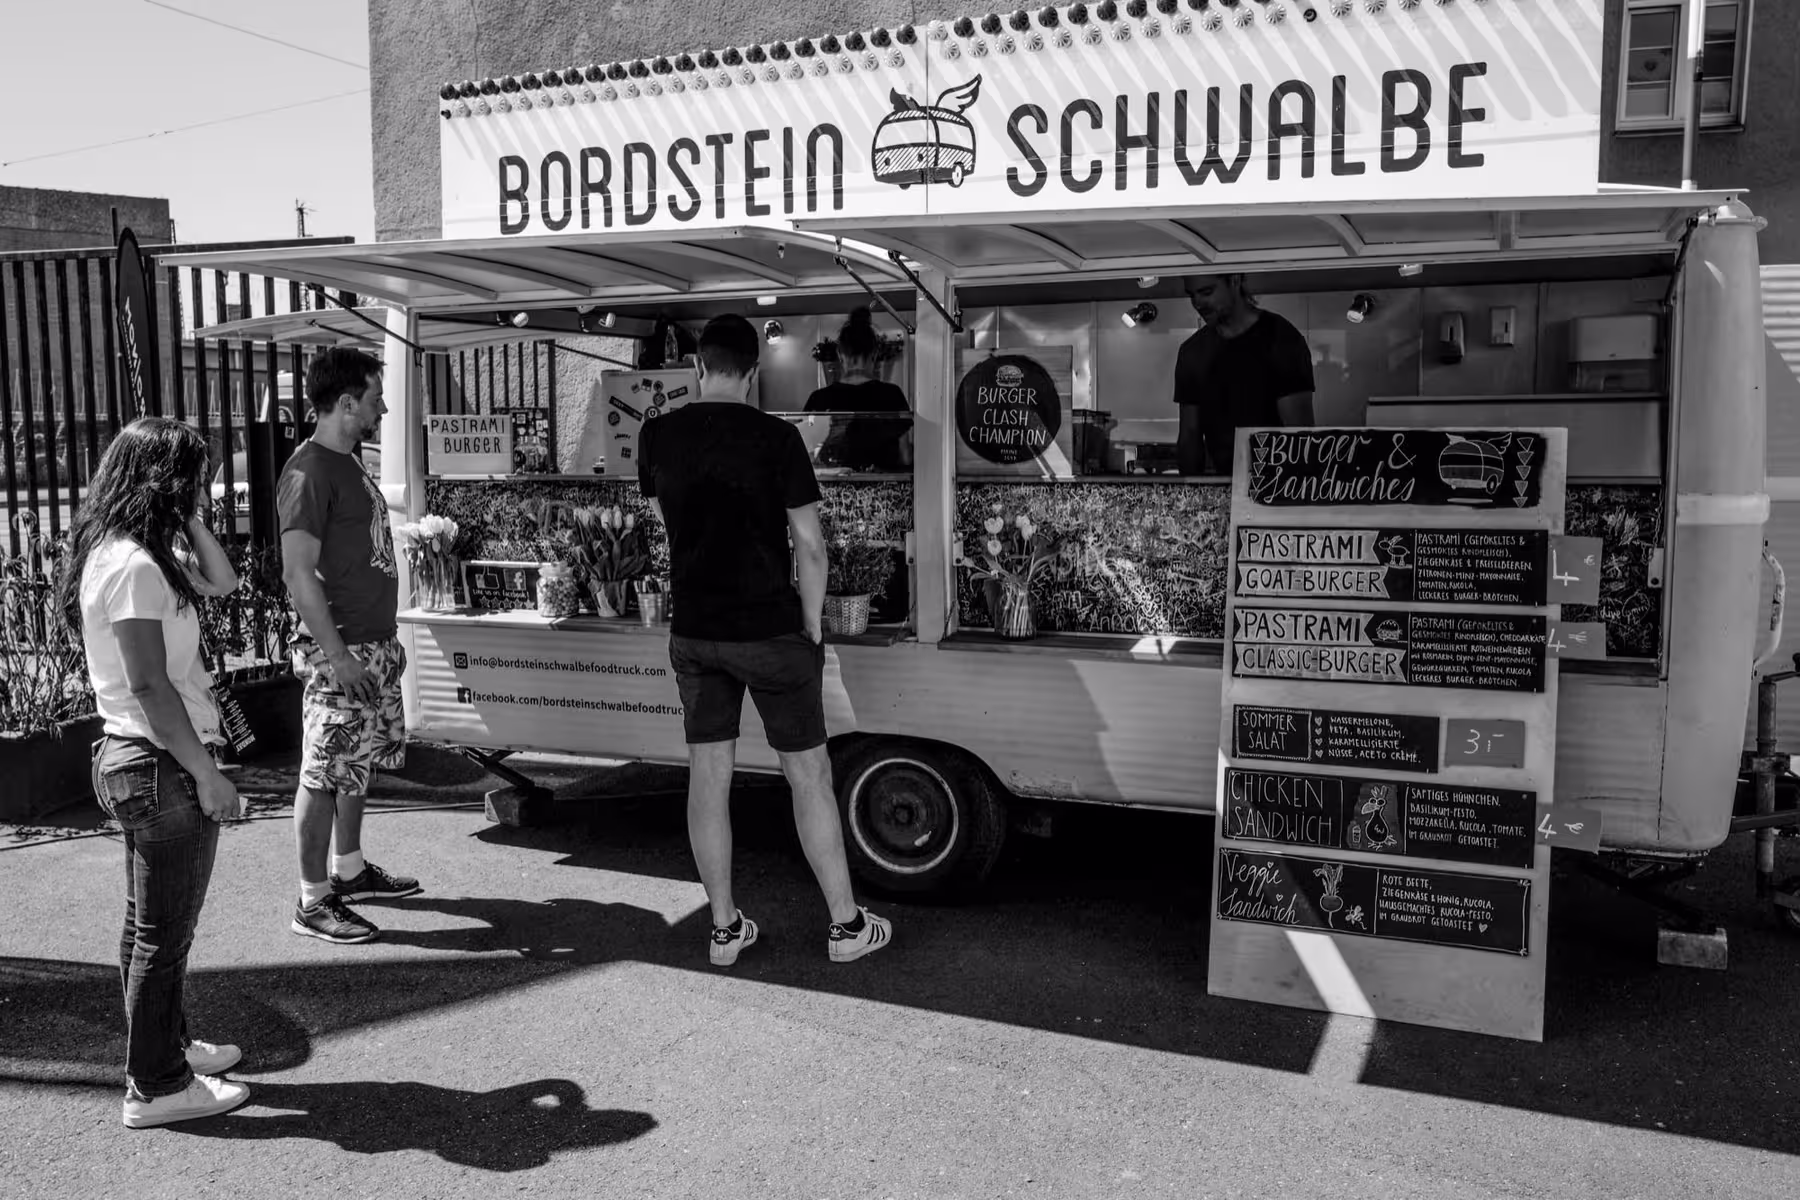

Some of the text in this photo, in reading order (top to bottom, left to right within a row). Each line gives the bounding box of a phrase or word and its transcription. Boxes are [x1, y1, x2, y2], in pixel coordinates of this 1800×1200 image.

[1006, 62, 1487, 197] SCHWALBE
[499, 123, 843, 235] BORDSTEIN
[978, 386, 1038, 405] BURGER
[431, 418, 504, 434] PASTRAMI
[983, 408, 1028, 426] CLASH
[969, 426, 1046, 446] CHAMPION
[1388, 433, 1417, 469] &
[1247, 533, 1363, 560] PASTRAMI
[1418, 532, 1460, 545] PASTRAMI
[1552, 548, 1580, 587] 4
[1245, 569, 1382, 594] GOAT-BURGER
[1243, 612, 1361, 642] PASTRAMI
[1412, 617, 1455, 630] PASTRAMI
[1547, 627, 1567, 653] 4
[469, 655, 666, 677] info@bordsteinschwalbefoodtruck.com
[1242, 648, 1397, 675] CLASSIC-BURGER
[1242, 712, 1297, 733] SOMMER
[1248, 731, 1288, 752] SALAT
[1359, 749, 1387, 760] ACETO
[1537, 813, 1557, 839] 4
[1382, 874, 1403, 886] ROTE
